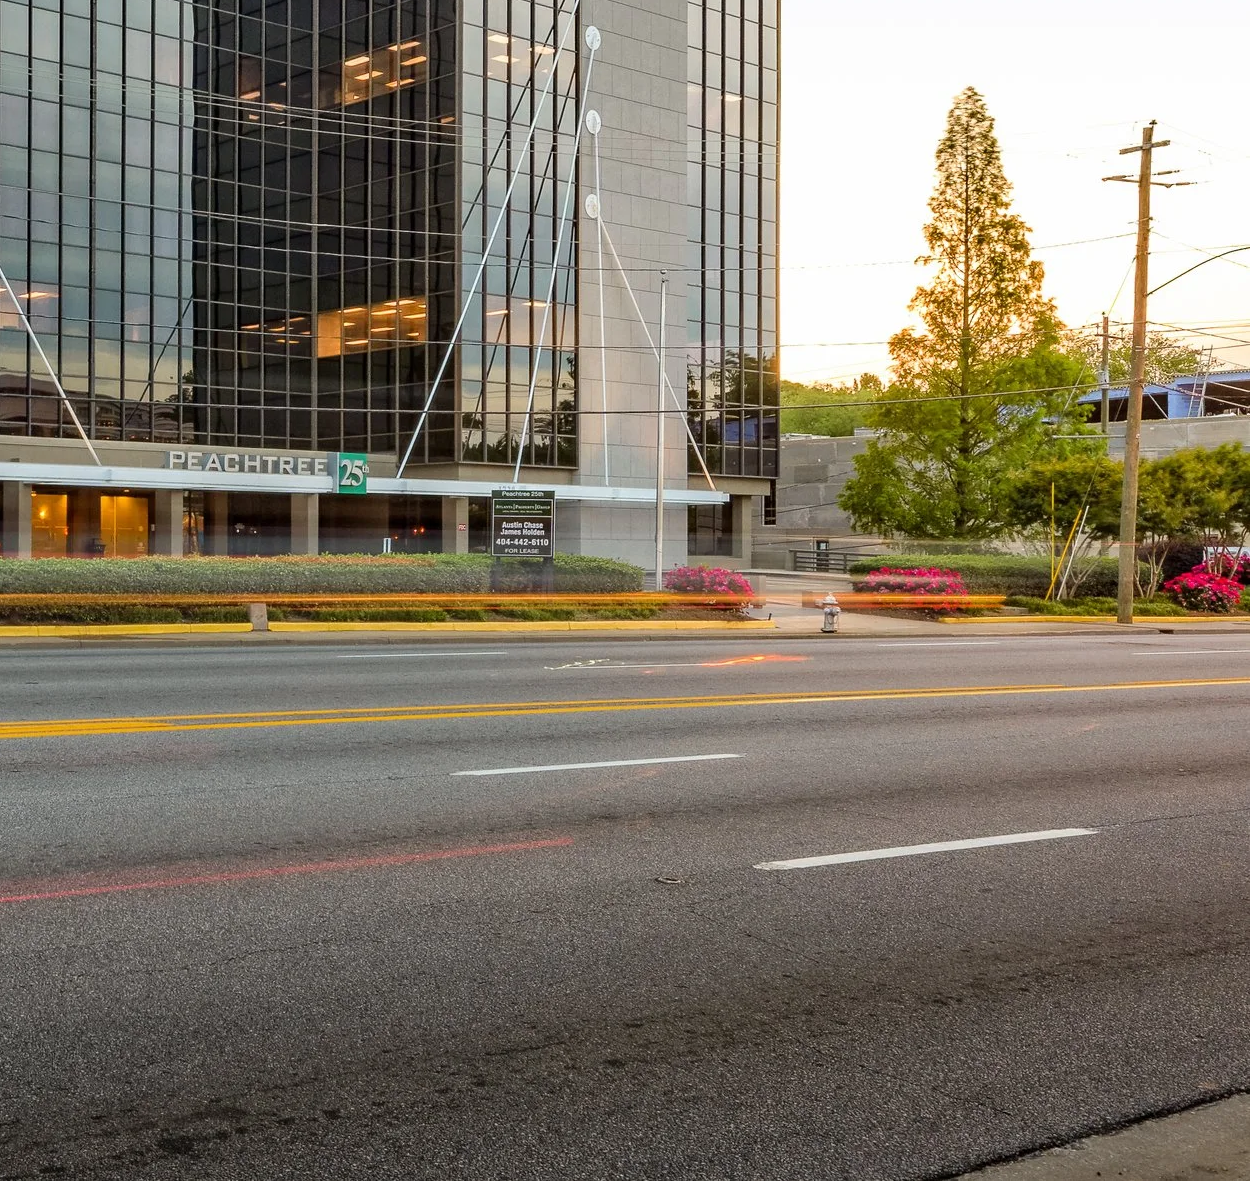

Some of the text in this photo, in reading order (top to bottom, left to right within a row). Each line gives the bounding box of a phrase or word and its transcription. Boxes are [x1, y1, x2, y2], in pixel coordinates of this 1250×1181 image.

[169, 451, 369, 486] PEACHTREE 25th
[501, 521, 522, 529] Austin
[495, 538, 549, 546] 404-442-6110
